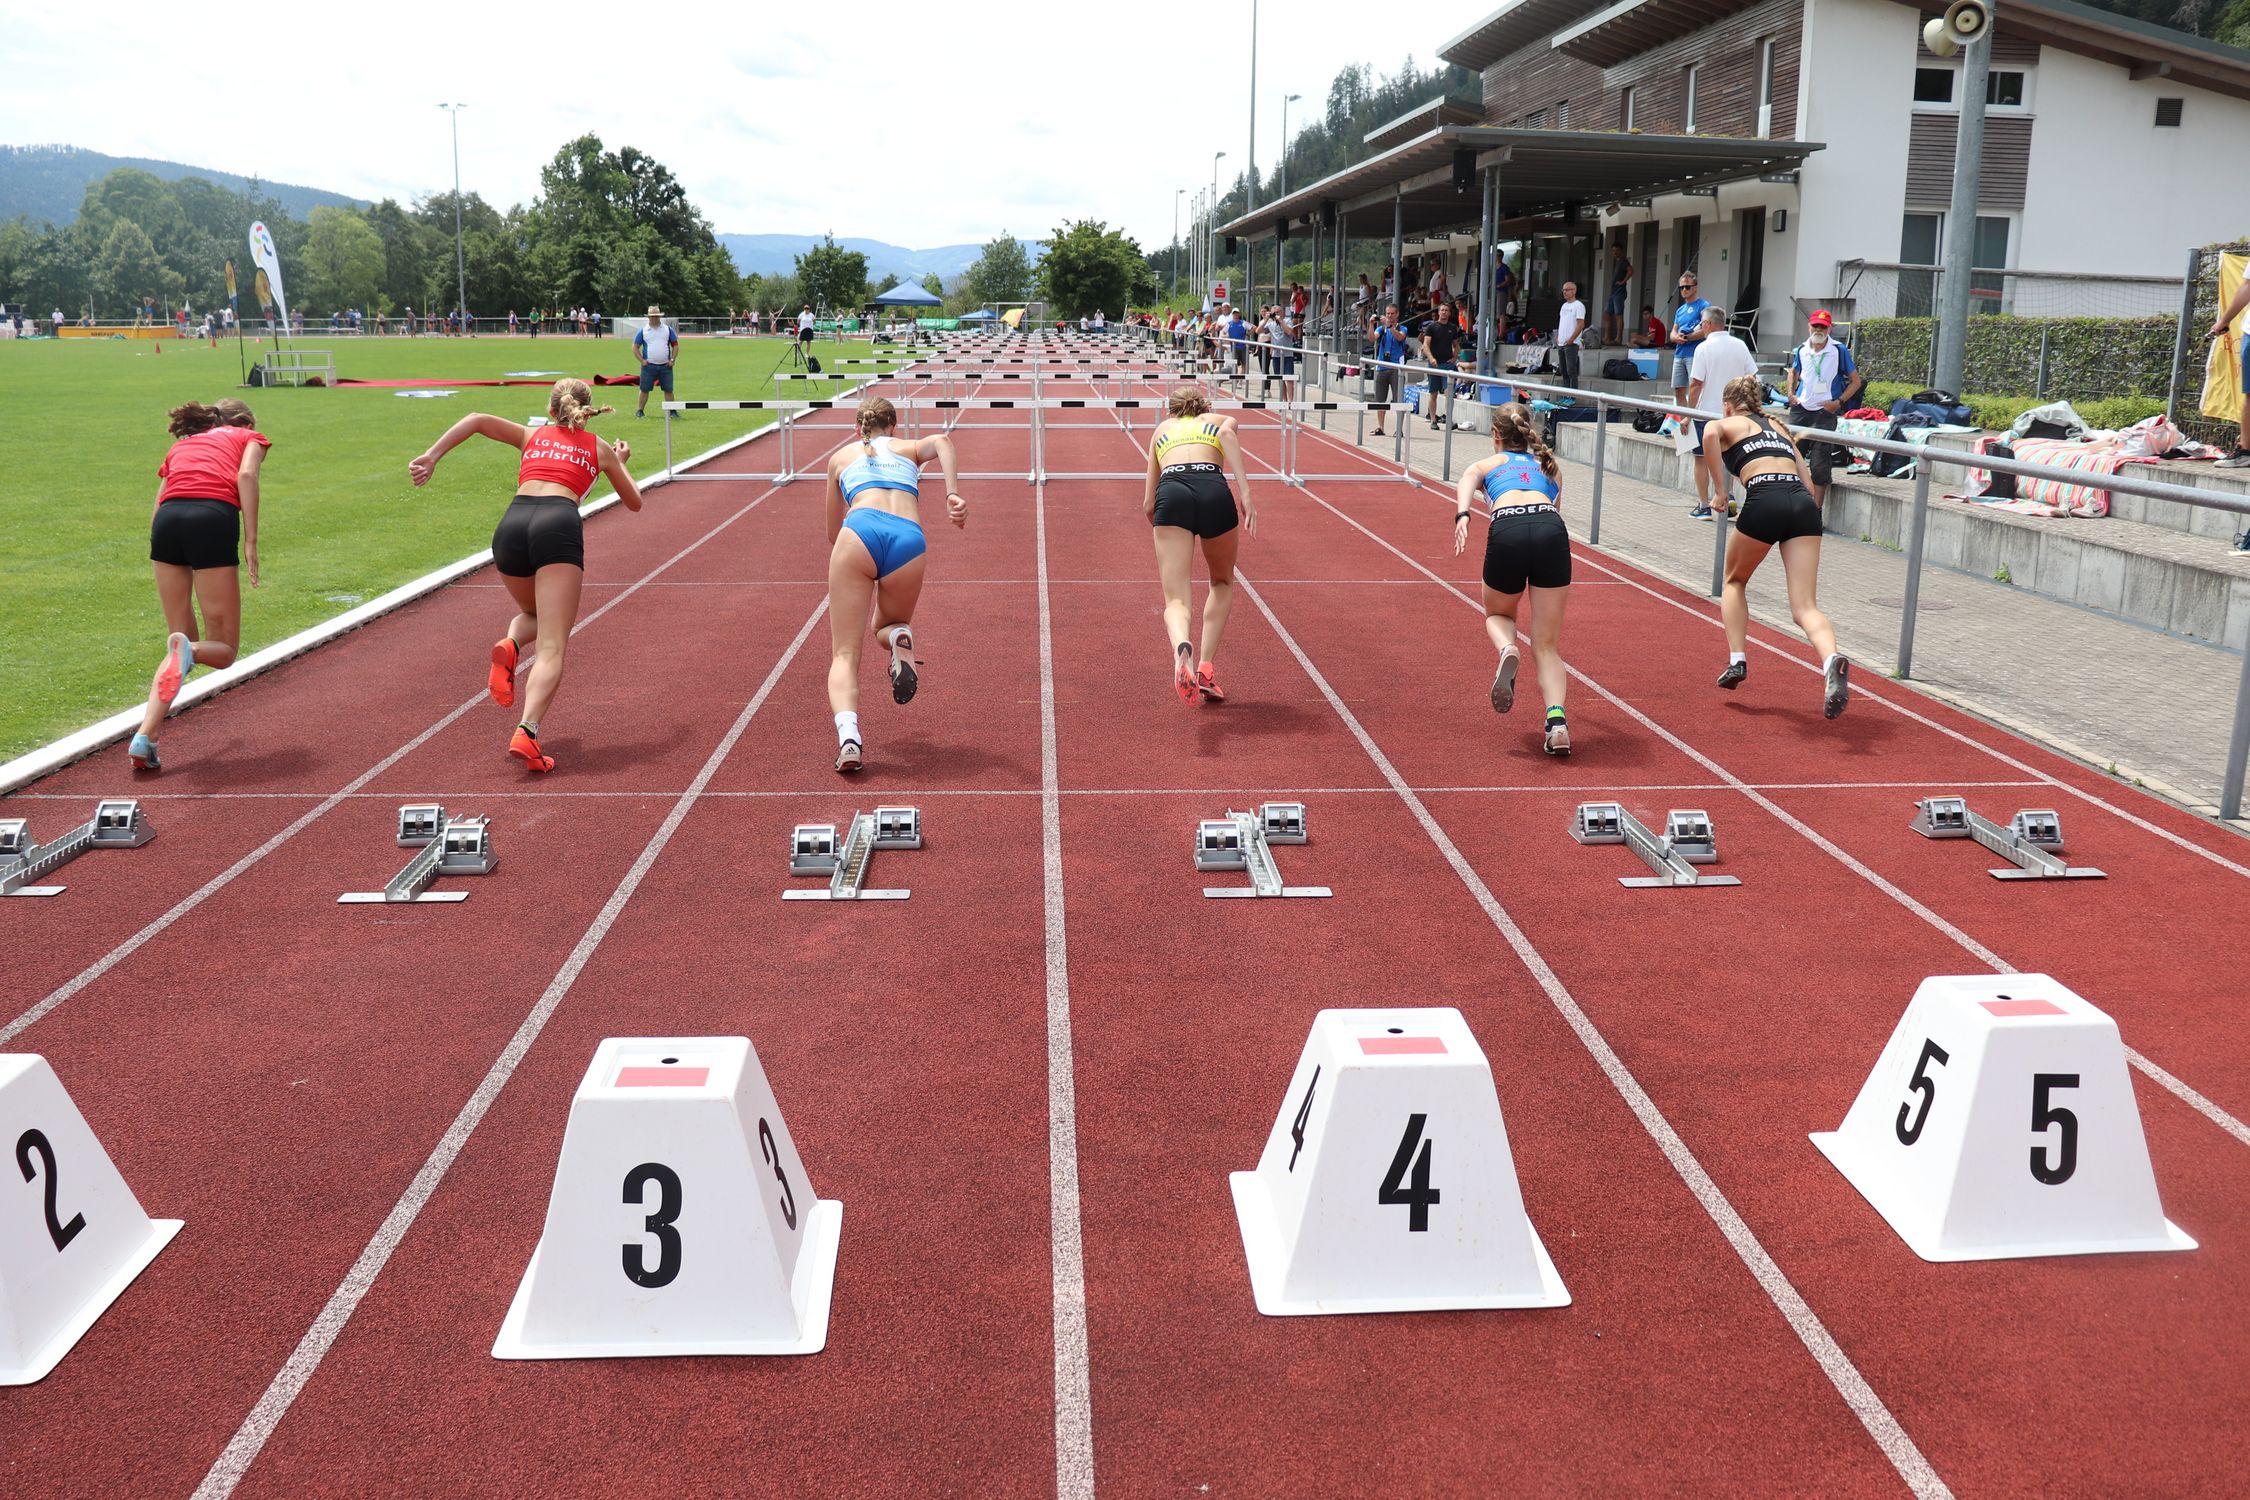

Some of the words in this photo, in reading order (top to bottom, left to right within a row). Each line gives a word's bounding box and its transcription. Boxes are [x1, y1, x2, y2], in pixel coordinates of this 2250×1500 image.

[522, 448, 597, 477] Karlsruhe
[535, 438, 550, 447] LG
[553, 441, 591, 457] Region
[1747, 474, 1776, 488] NIKE
[1763, 430, 1778, 440] TV
[1496, 507, 1526, 518] PRO
[1527, 505, 1537, 513] E
[1288, 1064, 1321, 1174] 4
[1896, 1038, 1950, 1146] 5
[2030, 1073, 2080, 1186] 5
[15, 1128, 87, 1254] 2
[621, 1162, 683, 1289] 3
[759, 1117, 797, 1231] 3
[1378, 1113, 1441, 1233] 4
